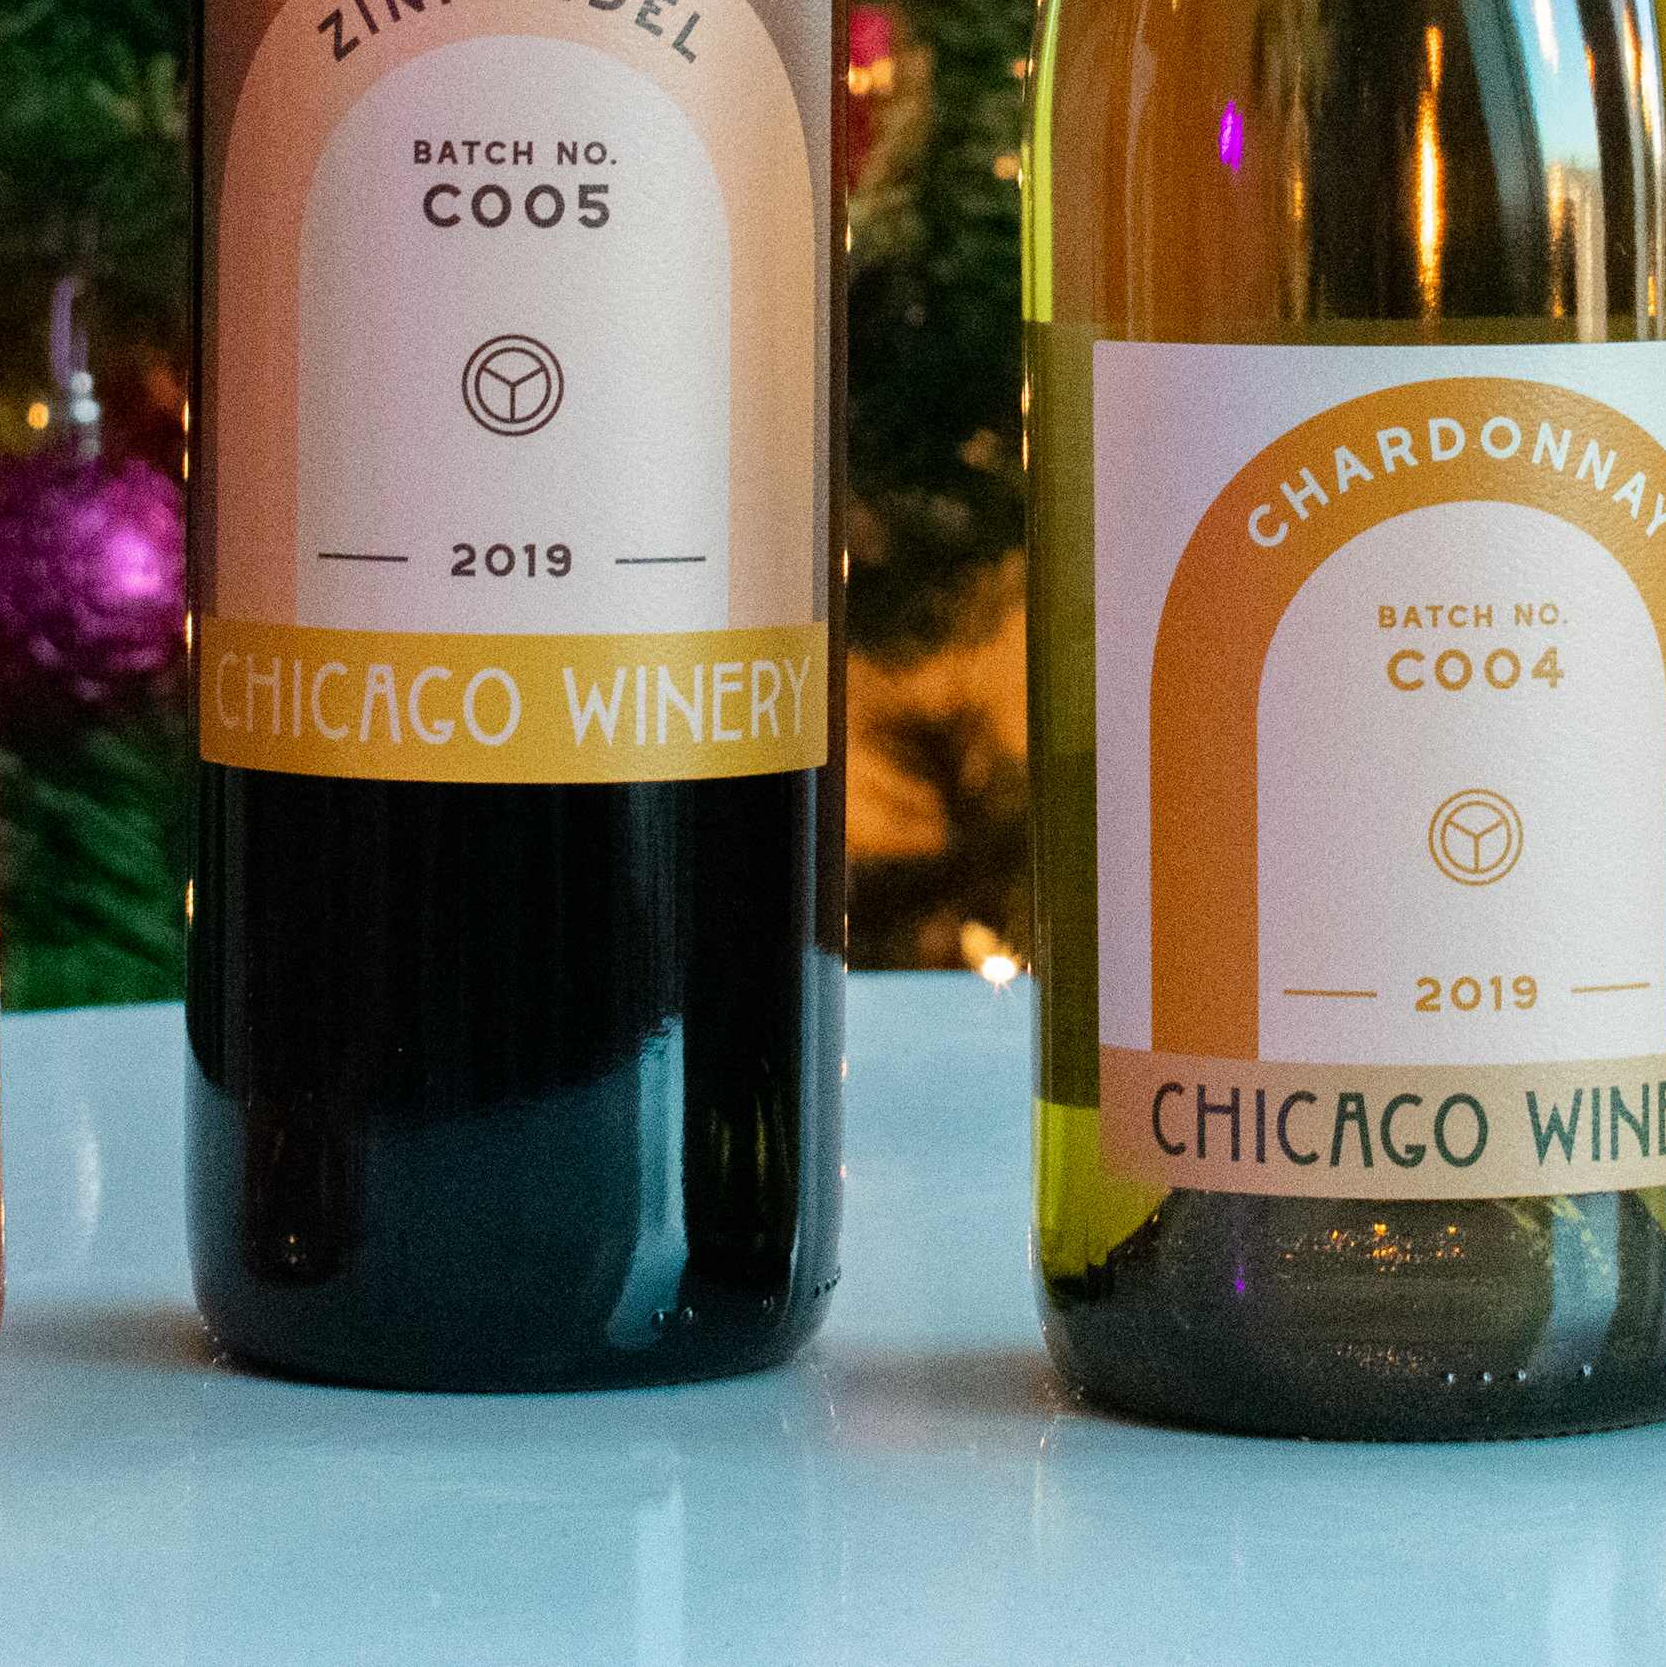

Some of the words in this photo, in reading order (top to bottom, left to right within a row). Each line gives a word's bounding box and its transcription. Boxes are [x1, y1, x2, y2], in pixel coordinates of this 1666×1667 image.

[413, 140, 534, 166] BATCH
[556, 140, 617, 164] NO.
[422, 183, 611, 229] C005
[451, 544, 573, 578] 2019
[1378, 604, 1493, 628] BATCH
[1513, 603, 1569, 626] NO.
[1386, 646, 1565, 691] C004
[215, 653, 521, 745] CHICAGO
[563, 655, 811, 747] WINERY
[1415, 975, 1539, 1012] 2019
[1152, 1081, 1489, 1168] CHICAGO
